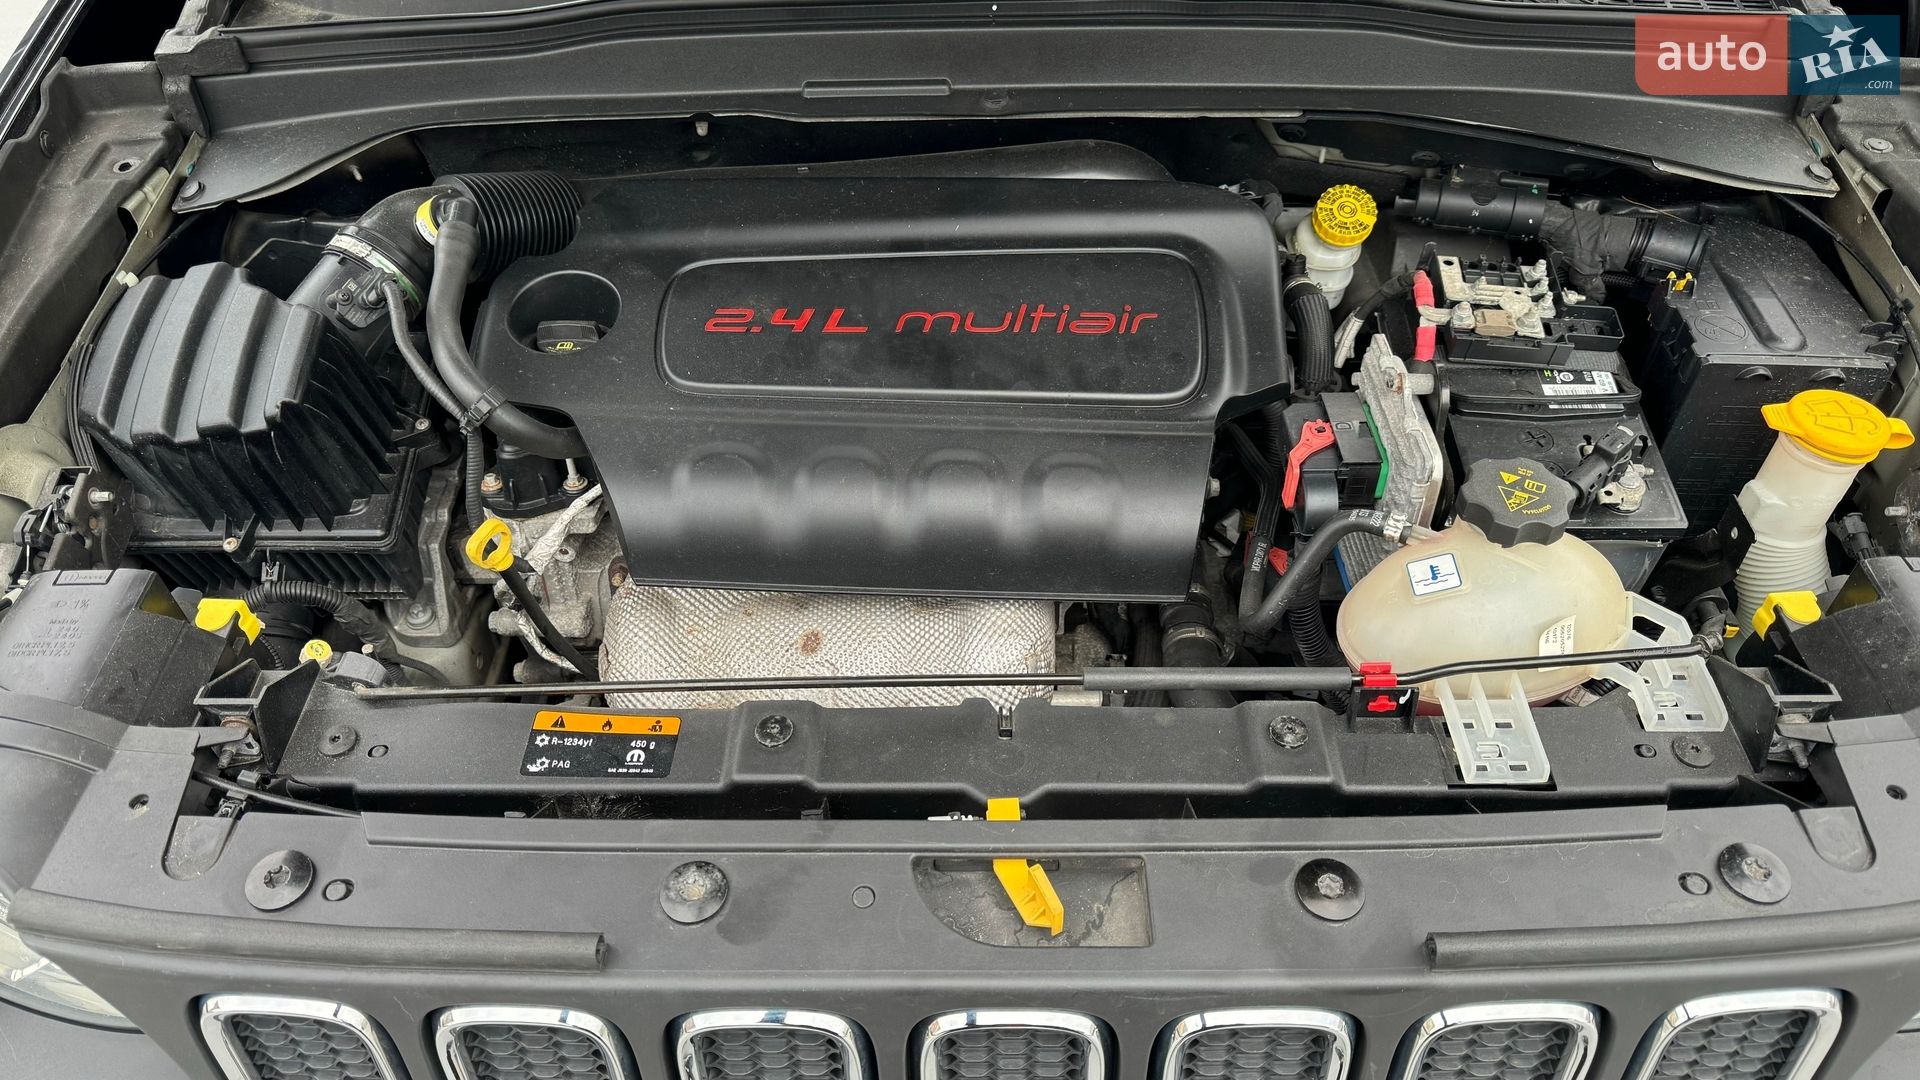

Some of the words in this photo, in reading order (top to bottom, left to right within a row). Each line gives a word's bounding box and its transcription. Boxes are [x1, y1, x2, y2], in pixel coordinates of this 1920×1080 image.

[895, 304, 1158, 334] multiair
[630, 740, 647, 748] 450
[551, 760, 571, 768] PAG
